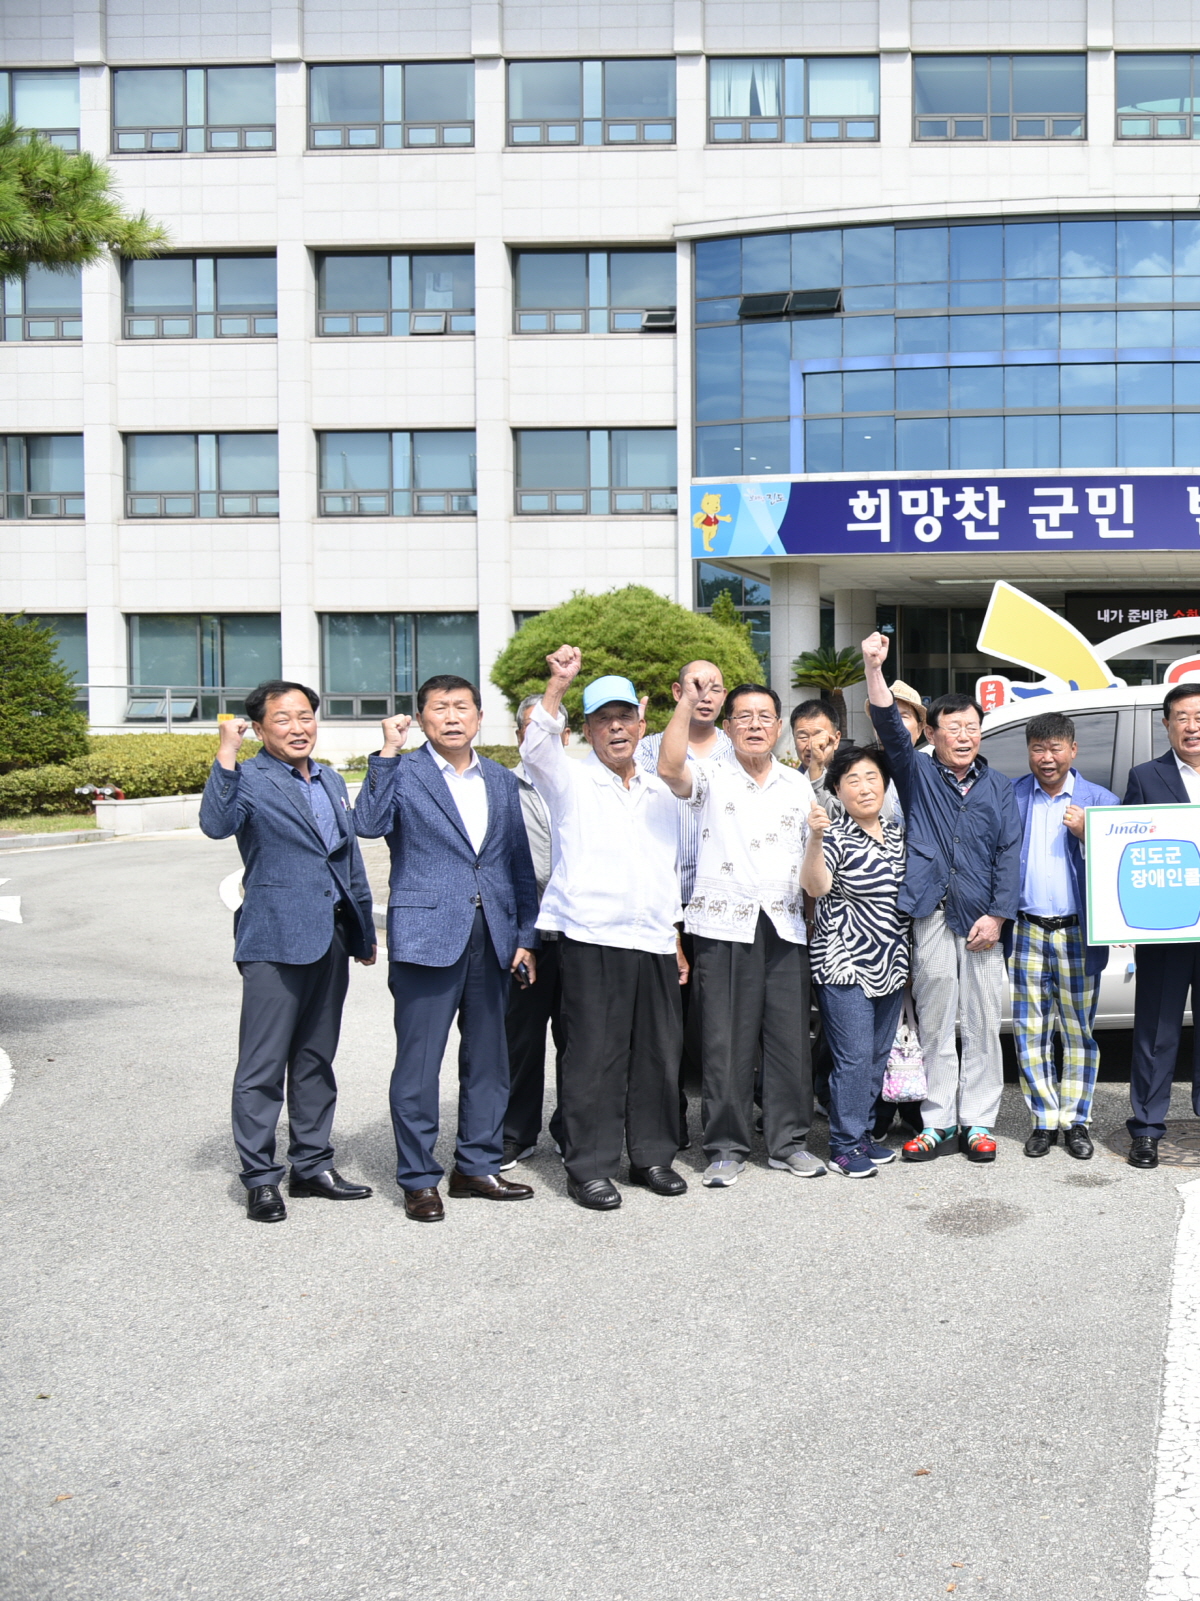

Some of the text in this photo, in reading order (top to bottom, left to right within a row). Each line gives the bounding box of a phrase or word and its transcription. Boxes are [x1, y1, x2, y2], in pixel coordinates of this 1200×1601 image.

[846, 485, 1006, 543] 희망찬
[1028, 484, 1134, 540] 군민
[1097, 609, 1124, 623] 내가
[1127, 609, 1169, 623] 준비한
[1130, 846, 1182, 866] 진도군
